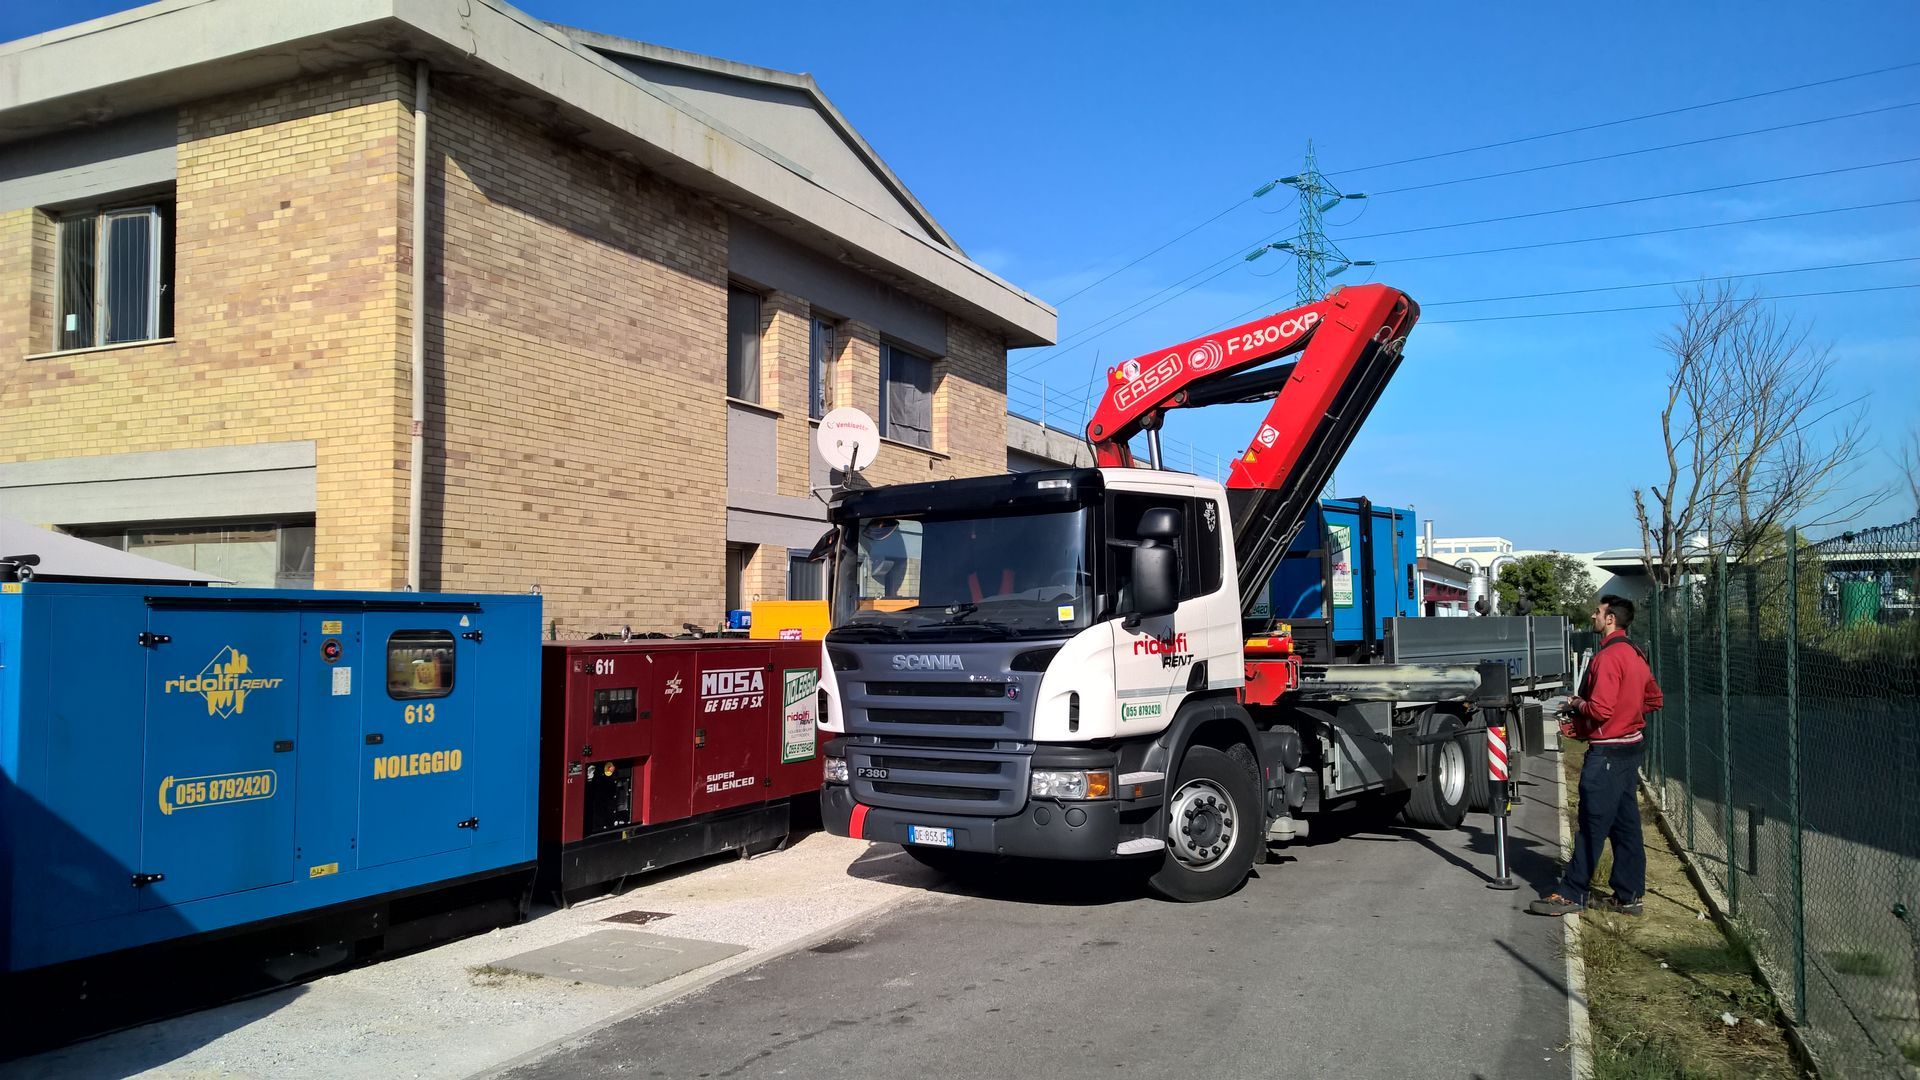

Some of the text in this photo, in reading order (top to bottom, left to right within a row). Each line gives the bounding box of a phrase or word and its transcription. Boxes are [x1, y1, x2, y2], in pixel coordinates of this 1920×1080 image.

[1226, 311, 1319, 356] F230CXP
[1118, 357, 1178, 406] FASSI
[1134, 633, 1188, 655] ridolfi
[595, 658, 615, 675] 611
[892, 654, 964, 671] SCANIA
[1162, 654, 1194, 669] RENT
[165, 673, 283, 693] ridolfi RENT
[701, 670, 764, 695] MOSA
[404, 703, 435, 724] 613
[704, 696, 764, 713] GE 165 P SX
[1126, 704, 1161, 717] 055 8792420
[374, 749, 462, 780] NOLEGGIO
[858, 768, 886, 778] P 380
[706, 771, 735, 783] SUPER
[706, 776, 755, 793] SILENCED
[176, 774, 270, 805] 055 8792420
